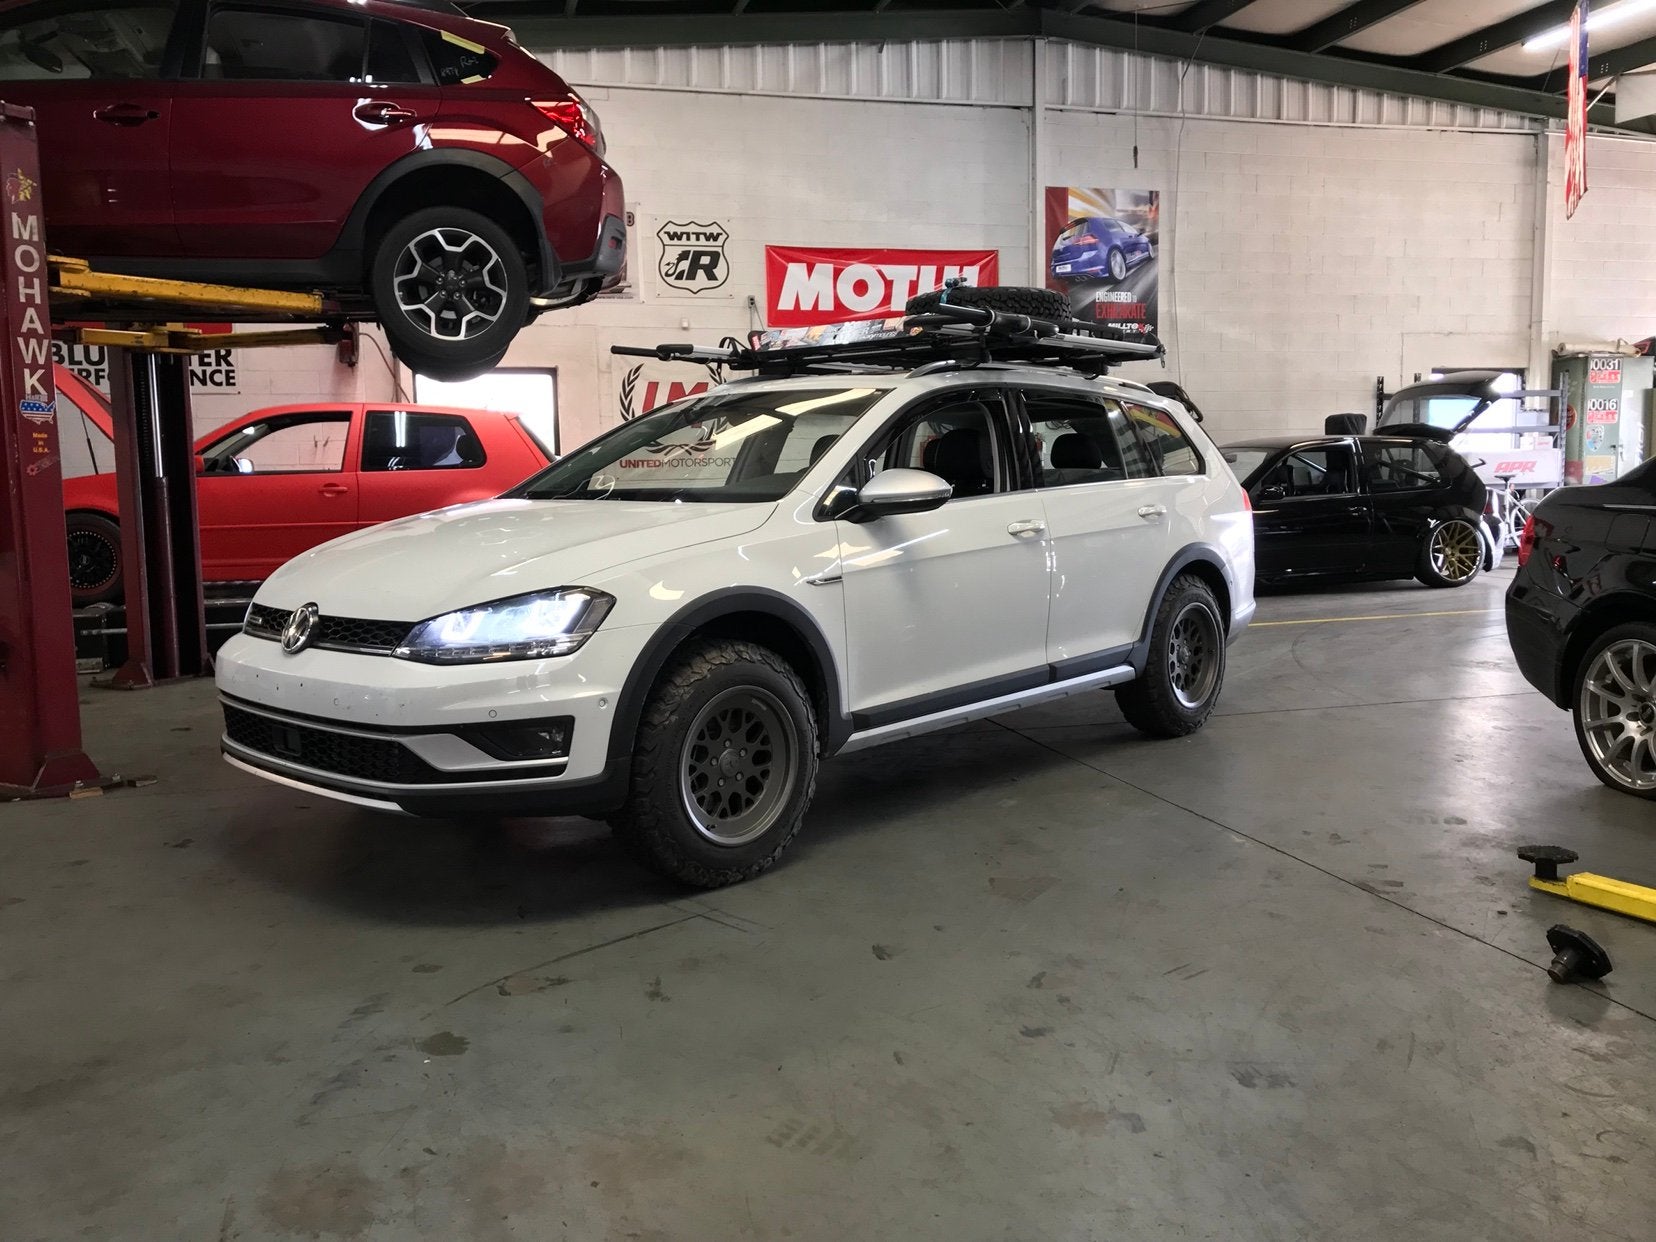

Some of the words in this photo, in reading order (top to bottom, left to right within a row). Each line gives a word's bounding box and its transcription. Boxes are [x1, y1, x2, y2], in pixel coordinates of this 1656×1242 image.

[663, 231, 723, 242] WITW
[1095, 291, 1132, 302] ENGINEERED
[11, 212, 50, 396] MOHAWK
[1095, 303, 1147, 319] EXHILARATE
[1494, 461, 1537, 474] APR
